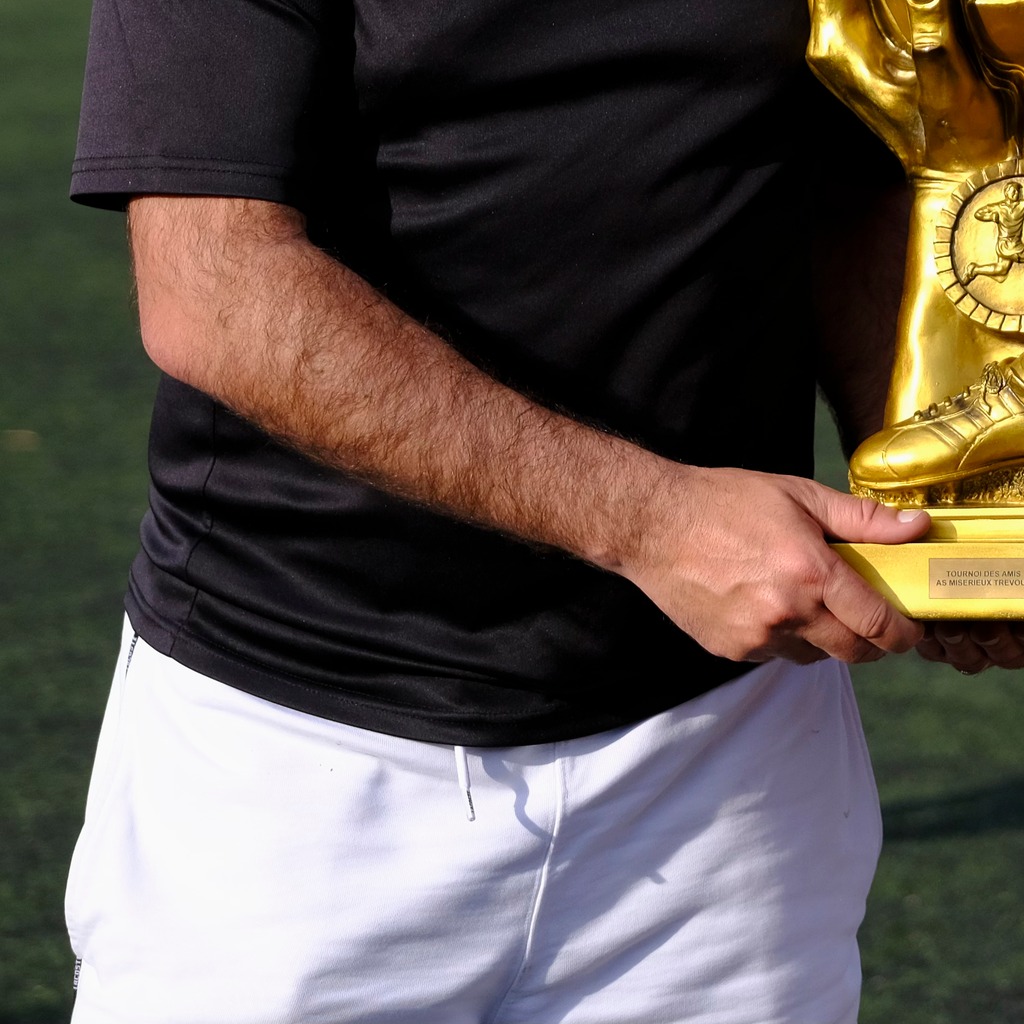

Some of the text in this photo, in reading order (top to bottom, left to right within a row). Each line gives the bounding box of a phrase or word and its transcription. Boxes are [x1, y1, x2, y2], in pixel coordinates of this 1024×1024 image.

[946, 570, 1021, 578] TOURNOI DES AMIS
[936, 579, 947, 587] AS
[948, 579, 992, 587] MISERIEUX
